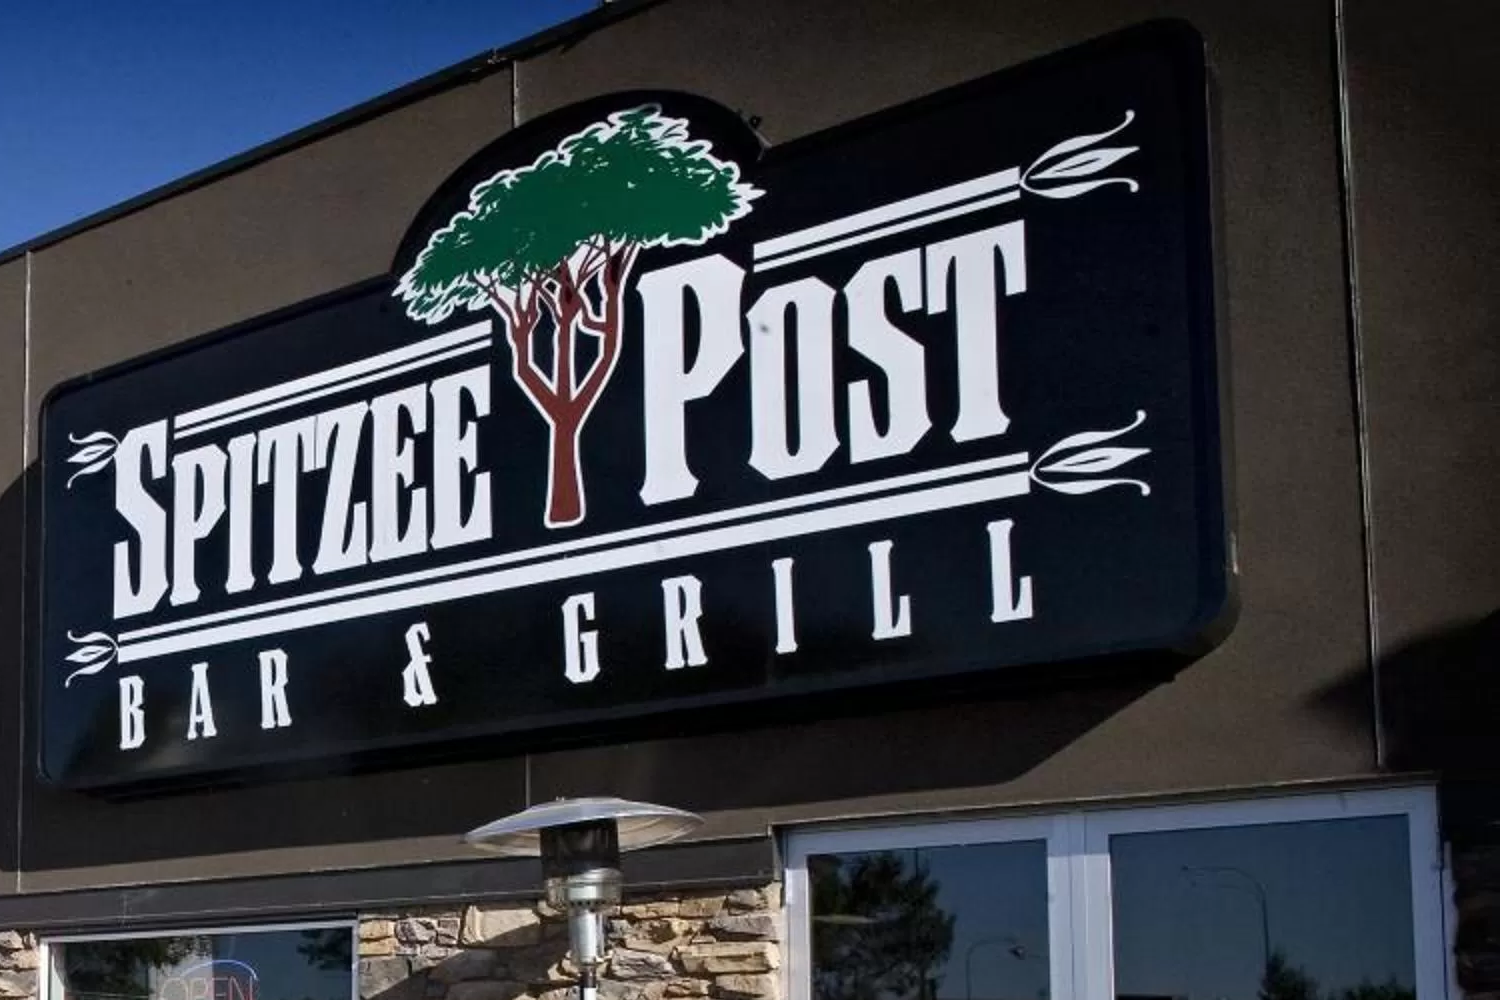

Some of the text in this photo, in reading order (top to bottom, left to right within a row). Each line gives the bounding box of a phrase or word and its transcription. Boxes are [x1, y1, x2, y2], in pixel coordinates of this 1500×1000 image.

[113, 219, 1027, 620] SPITZEE POST
[119, 519, 1033, 750] BAR & GRILL
